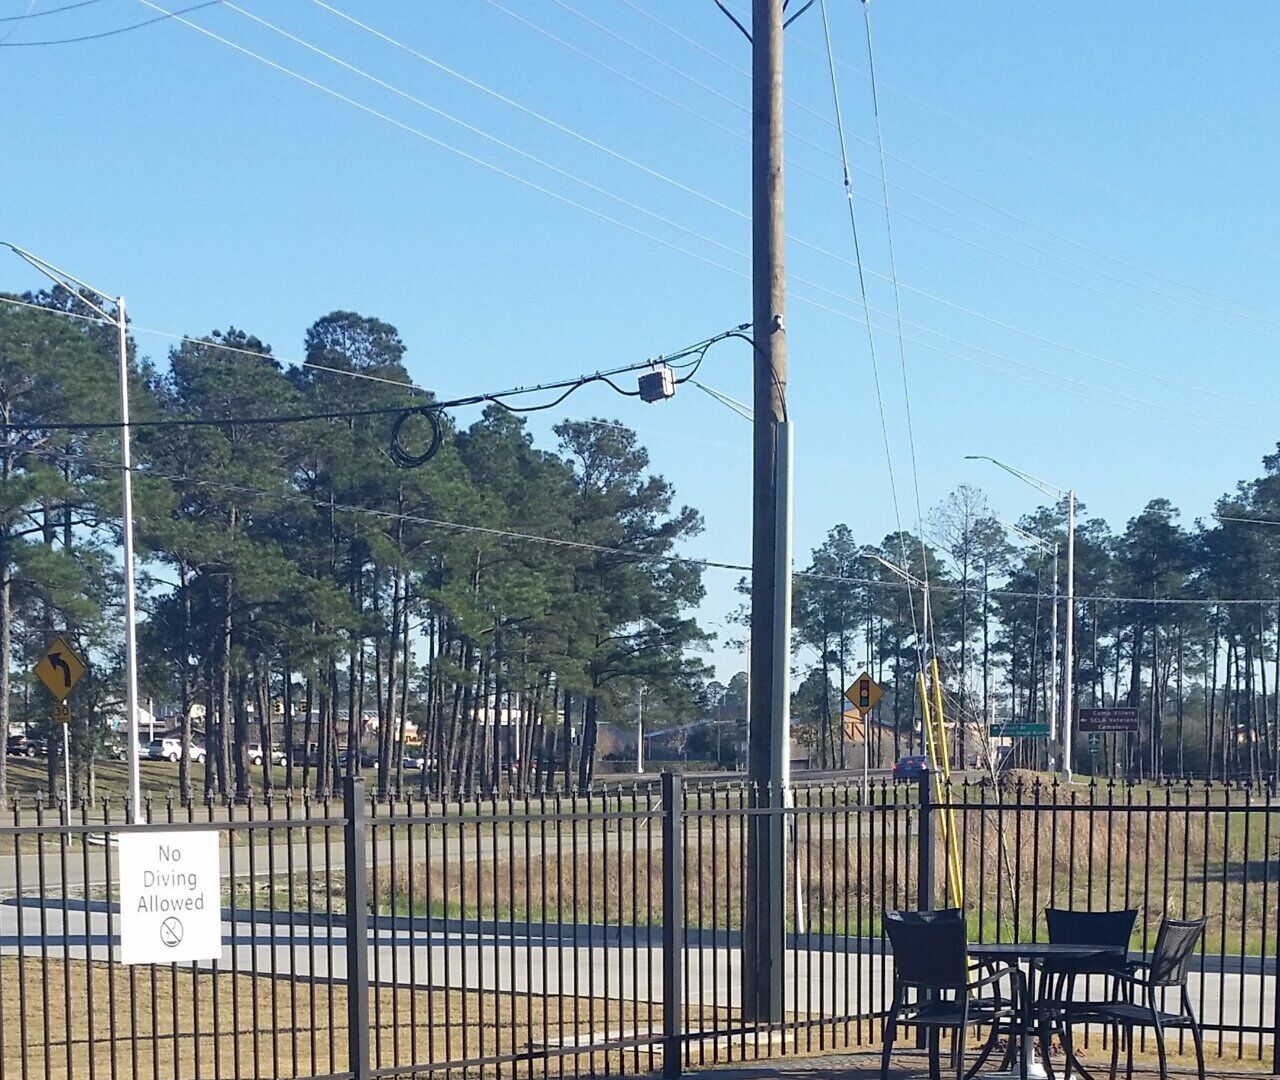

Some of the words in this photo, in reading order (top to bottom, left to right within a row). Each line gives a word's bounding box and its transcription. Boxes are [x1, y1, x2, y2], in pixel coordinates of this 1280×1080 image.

[55, 706, 69, 716] 30
[159, 845, 181, 862] No
[144, 869, 197, 891] Diving
[137, 892, 204, 913] Allowed
